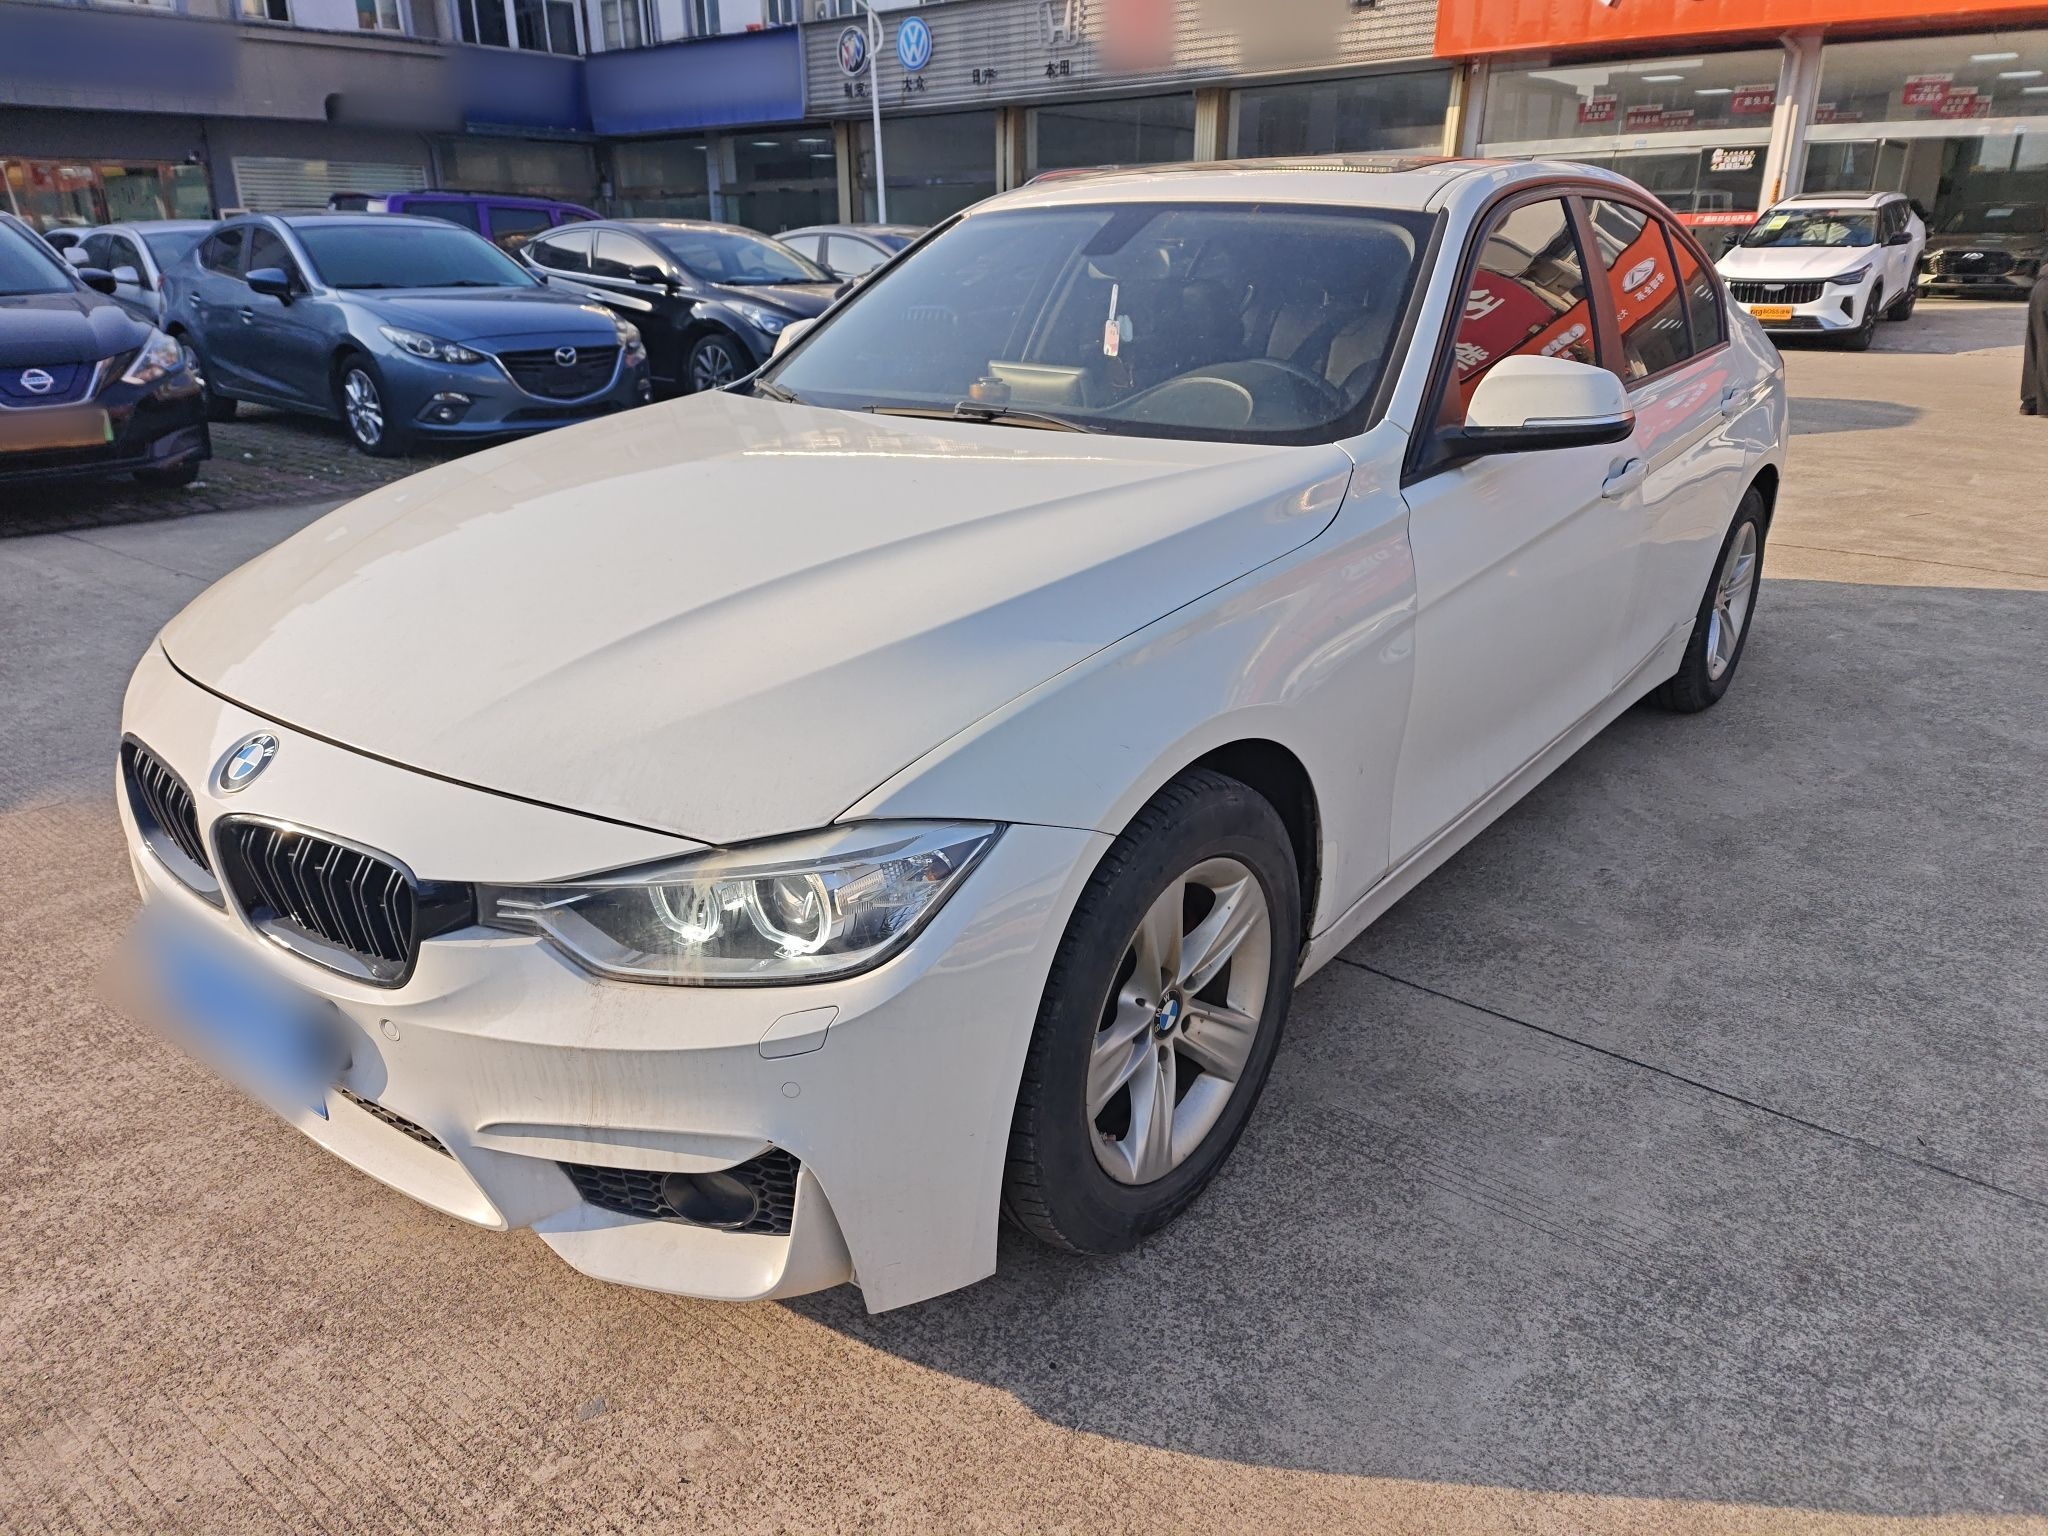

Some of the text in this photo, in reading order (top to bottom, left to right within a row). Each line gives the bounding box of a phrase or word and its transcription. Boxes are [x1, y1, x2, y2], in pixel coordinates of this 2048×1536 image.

[971, 68, 998, 85] 日产
[1044, 59, 1071, 79] 本田
[902, 75, 927, 92] 大众
[1154, 992, 1171, 1033] BMW
